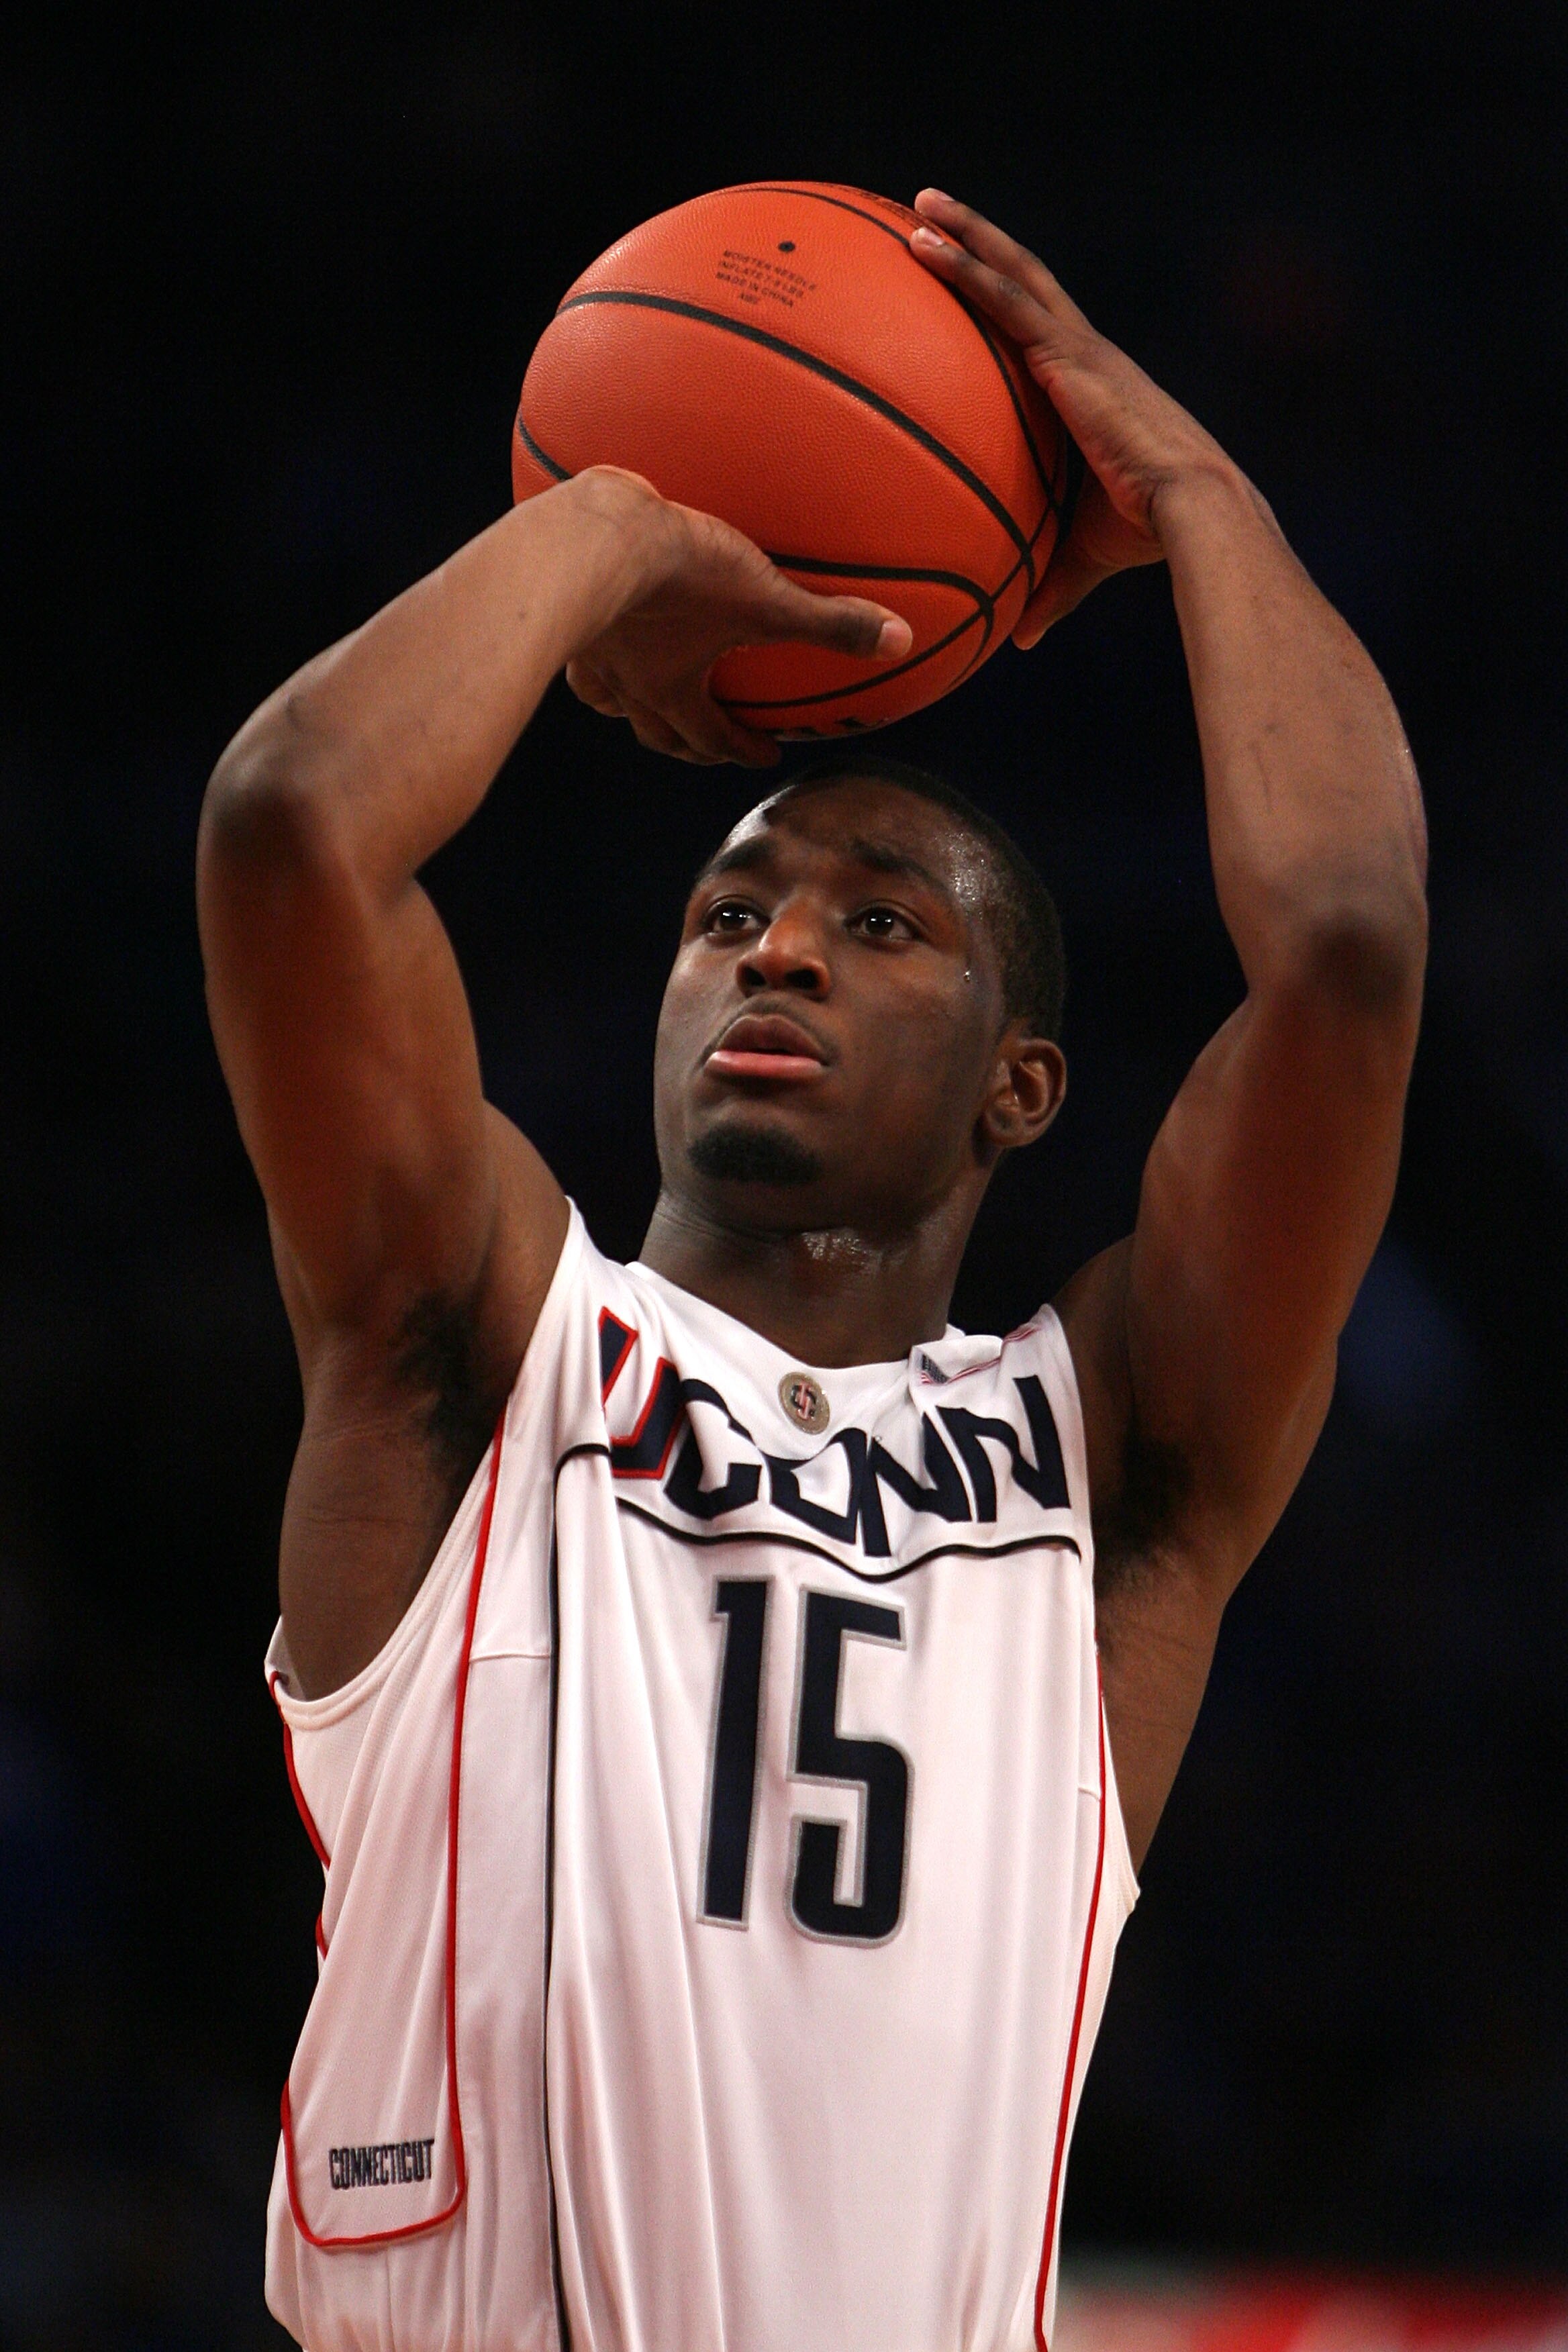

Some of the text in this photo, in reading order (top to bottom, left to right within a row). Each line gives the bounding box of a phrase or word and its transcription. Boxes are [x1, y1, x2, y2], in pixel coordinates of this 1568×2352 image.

[716, 271, 747, 287] MADE
[749, 281, 759, 292] IN
[761, 287, 794, 307] CHINA
[719, 260, 763, 279] INFLATE
[775, 266, 816, 291] NEEDLE
[597, 1306, 1072, 1558] UCONN
[696, 1575, 916, 1949] 15
[329, 2138, 435, 2190] CONNECTICUT
